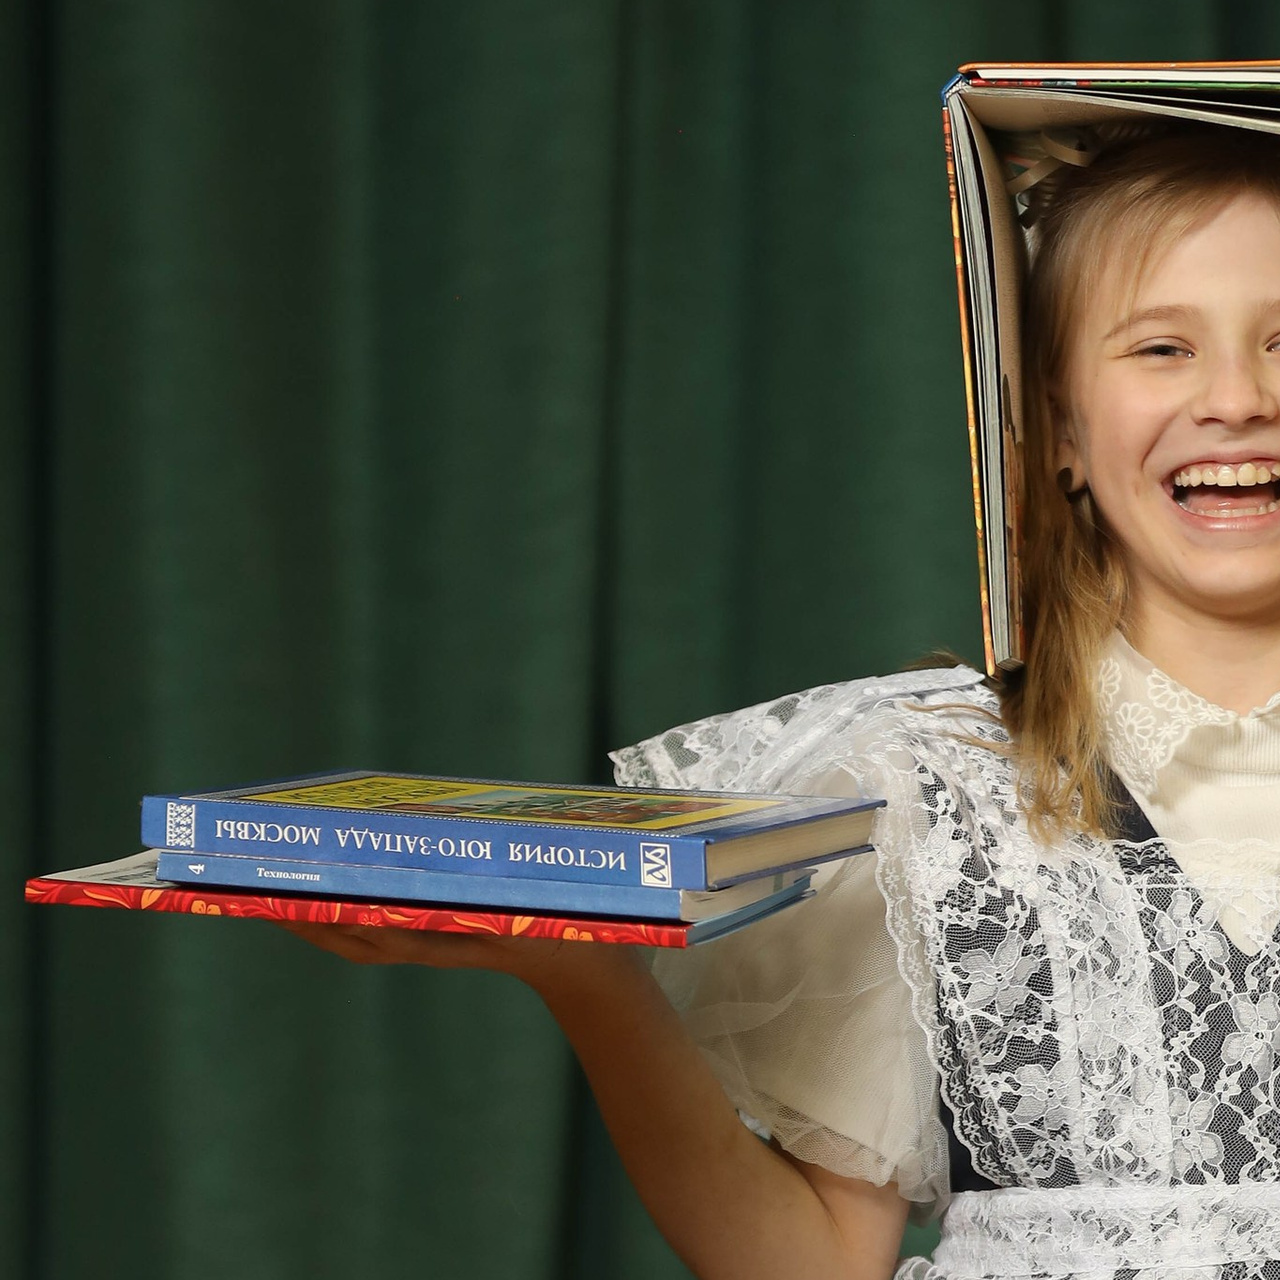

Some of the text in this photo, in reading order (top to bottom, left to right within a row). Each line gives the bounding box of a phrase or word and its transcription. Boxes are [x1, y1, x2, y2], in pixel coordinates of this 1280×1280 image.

[215, 819, 627, 872] ИСТОРИЯ ЮГО-ЗАПАДА МОСКВЫ
[188, 863, 205, 875] 4
[256, 867, 321, 882] Технология
